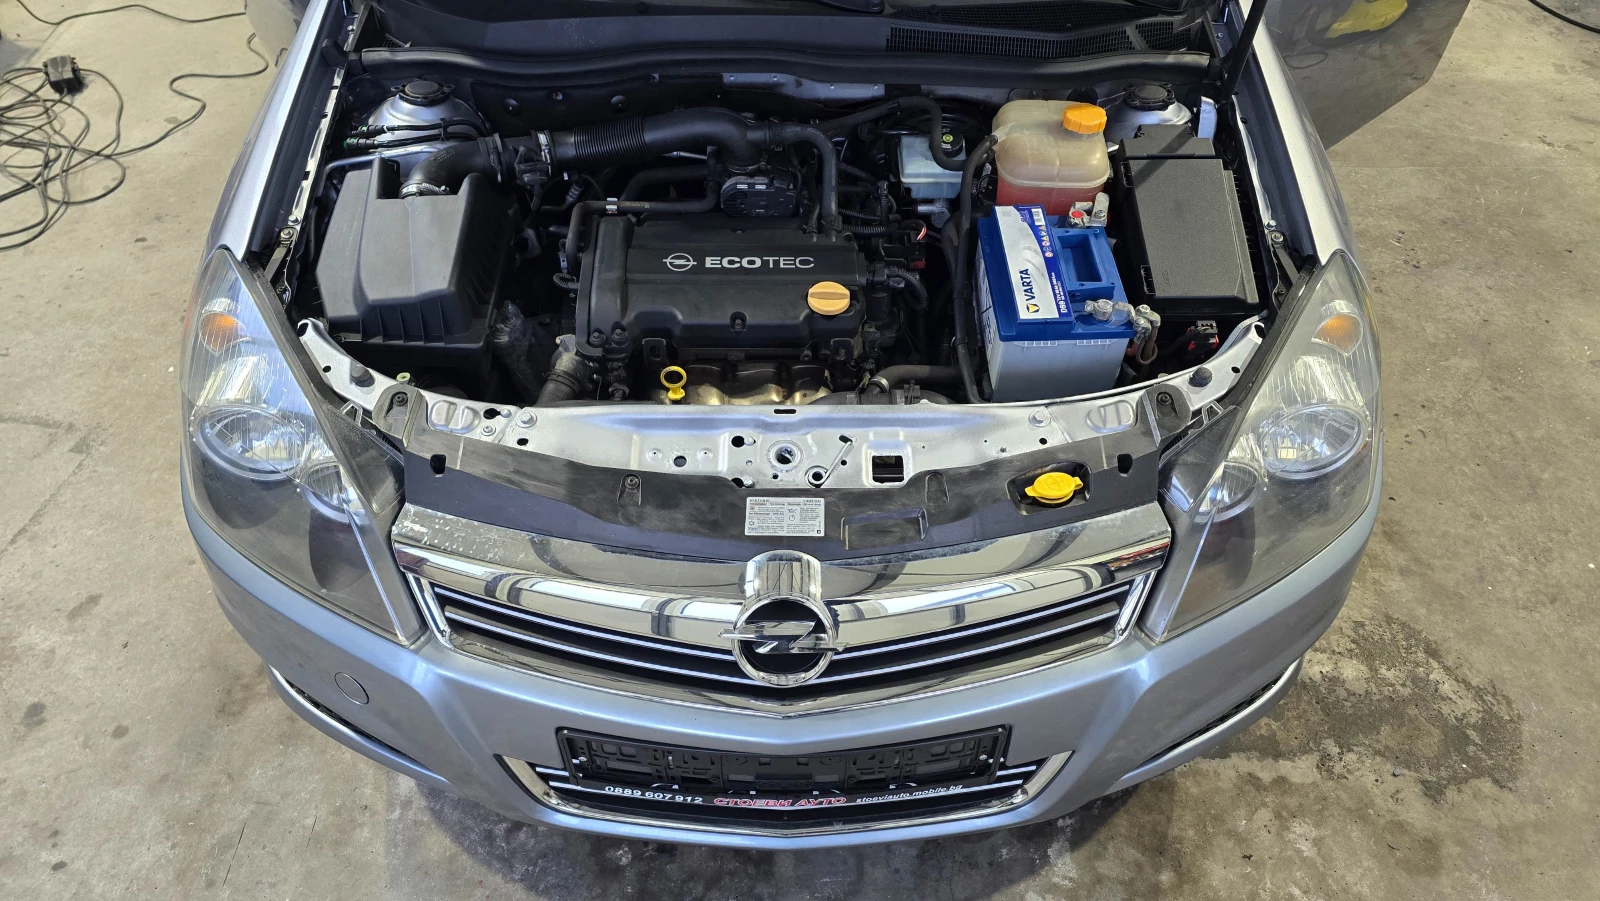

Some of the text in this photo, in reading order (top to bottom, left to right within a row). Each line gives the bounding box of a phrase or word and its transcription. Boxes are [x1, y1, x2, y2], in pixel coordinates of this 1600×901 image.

[705, 256, 815, 269] ECOTEC
[1019, 268, 1036, 301] VARTA
[604, 786, 703, 805] 0889 607 912
[855, 784, 964, 803] stoeviauto.mobile.bg
